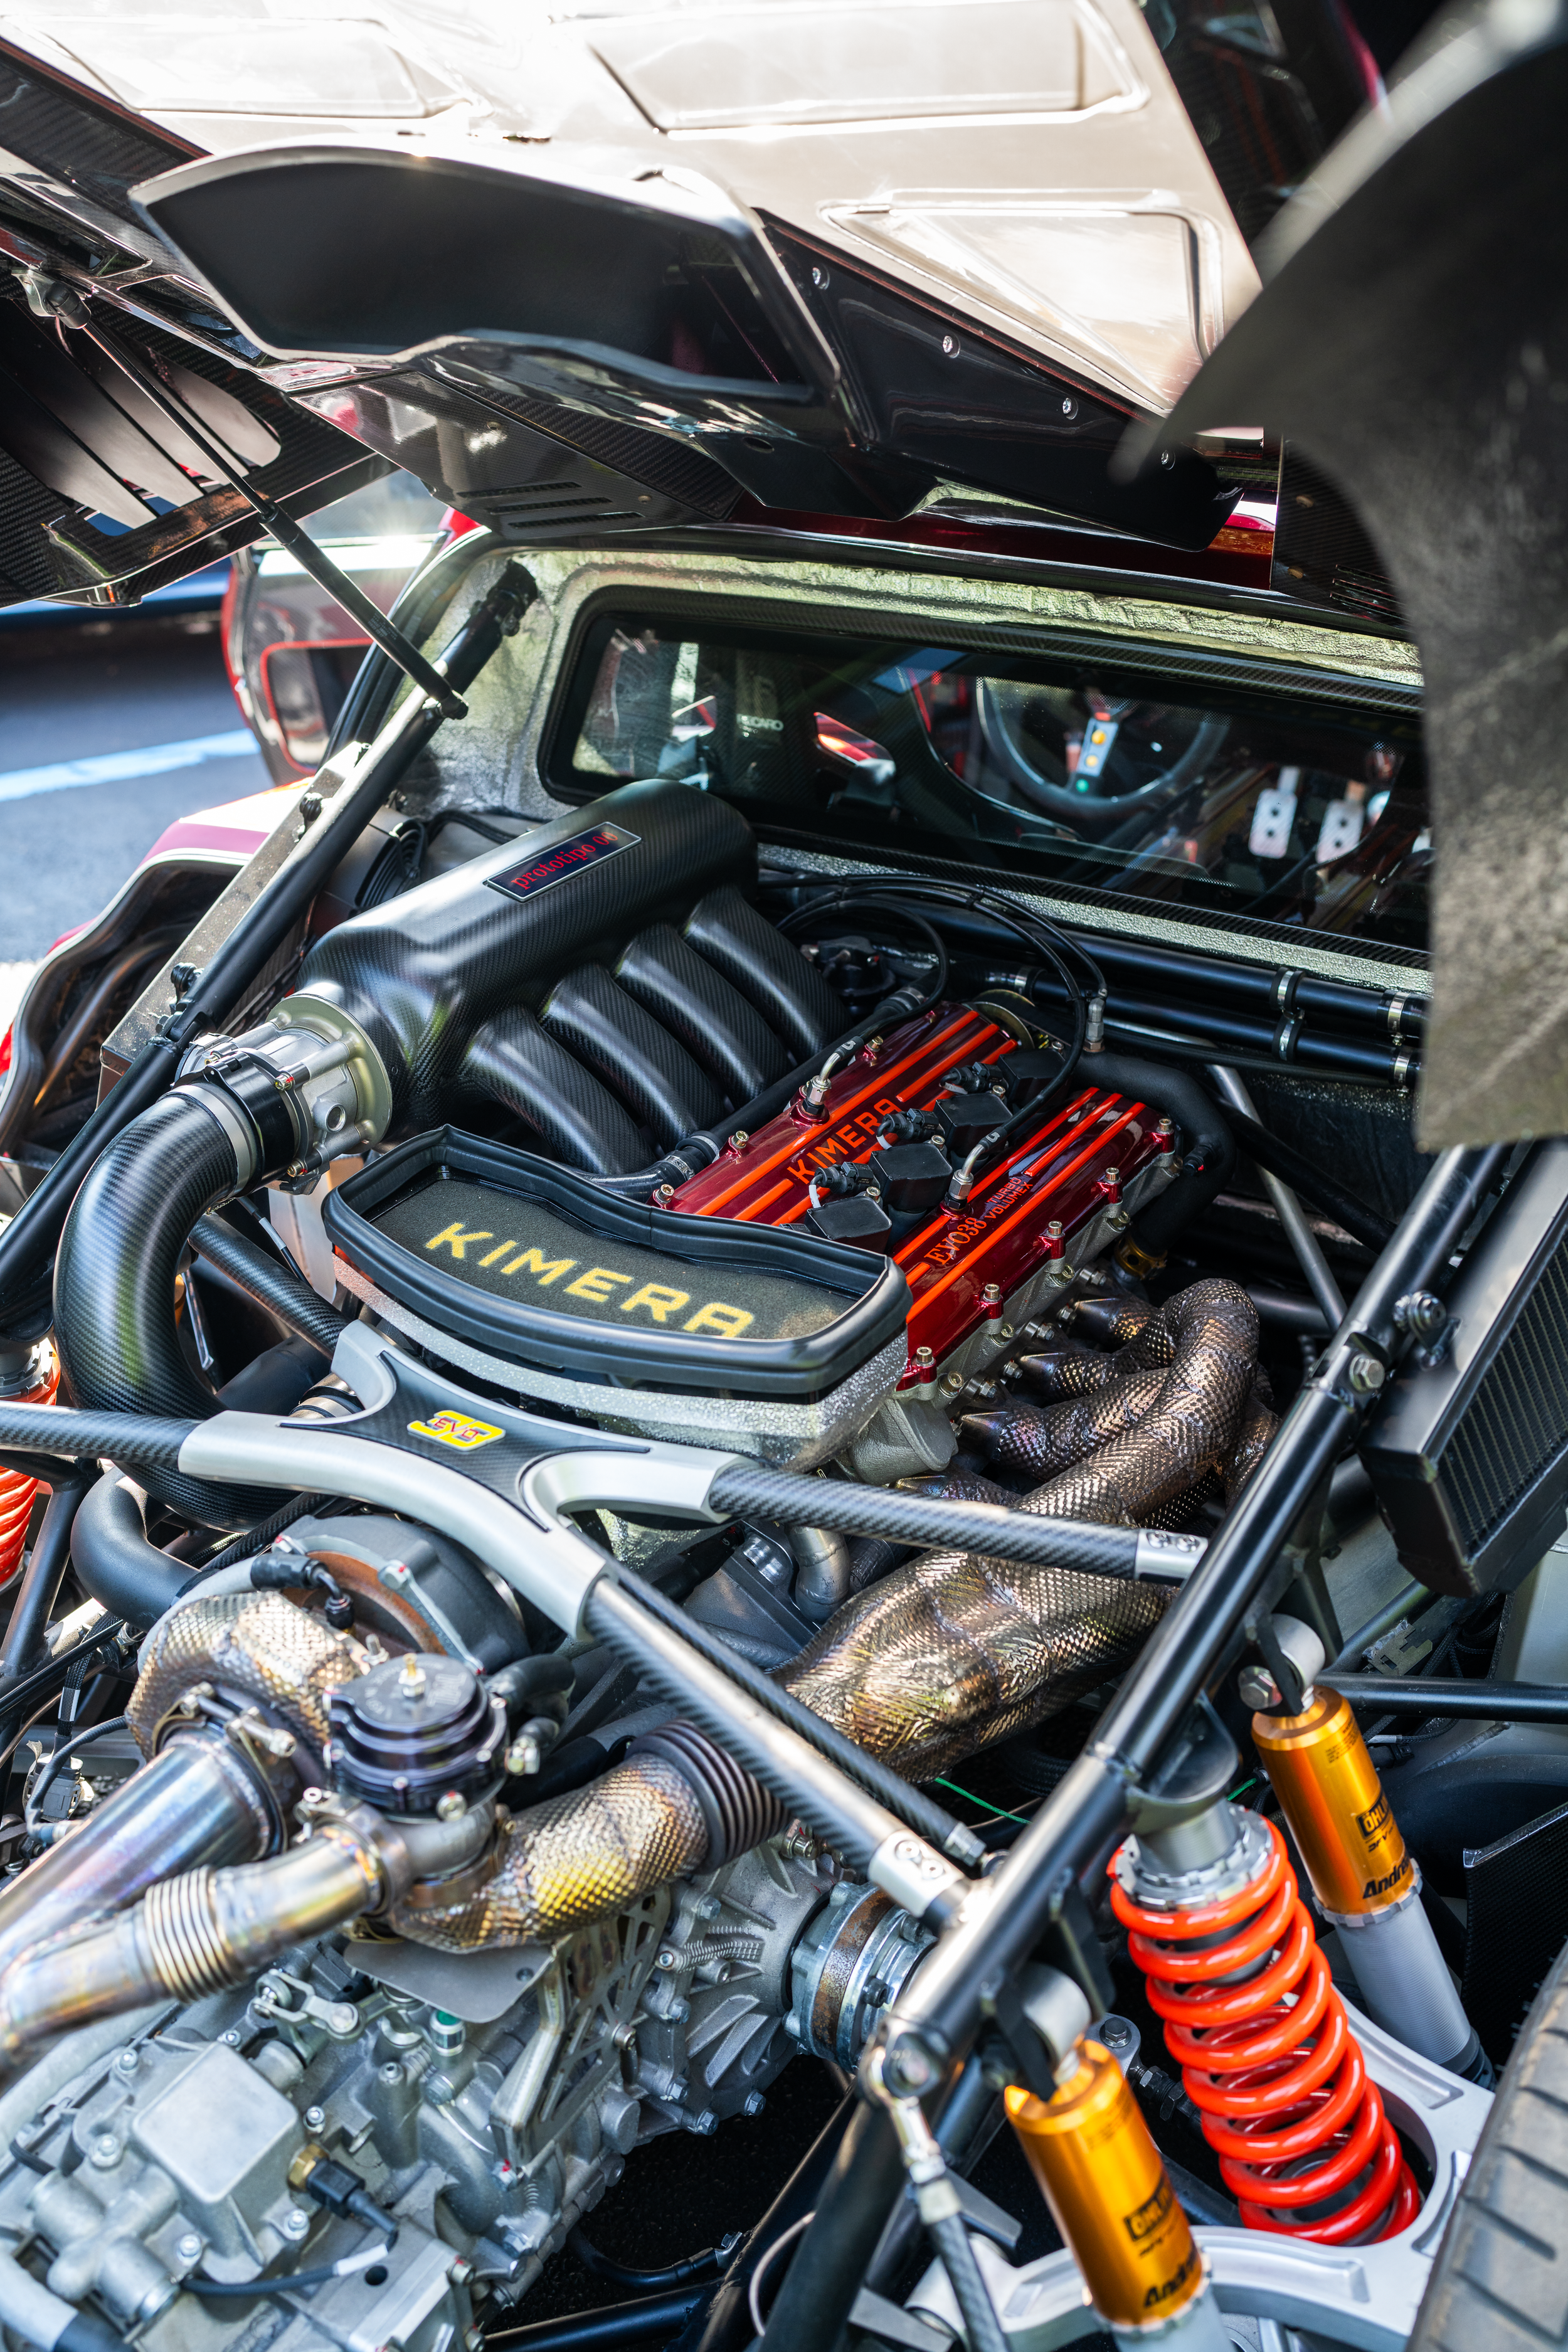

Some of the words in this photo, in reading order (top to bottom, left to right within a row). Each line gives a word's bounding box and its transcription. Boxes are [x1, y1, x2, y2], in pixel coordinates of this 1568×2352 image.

[511, 843, 596, 890] prototipo
[595, 832, 618, 846] 00
[787, 1098, 902, 1185] KIMERA
[984, 1182, 1033, 1219] VOLUMEX
[987, 1177, 1022, 1204] TURBO
[923, 1217, 987, 1266] EVO38
[425, 1222, 755, 1338] KIMERA
[433, 1417, 480, 1439] EVO
